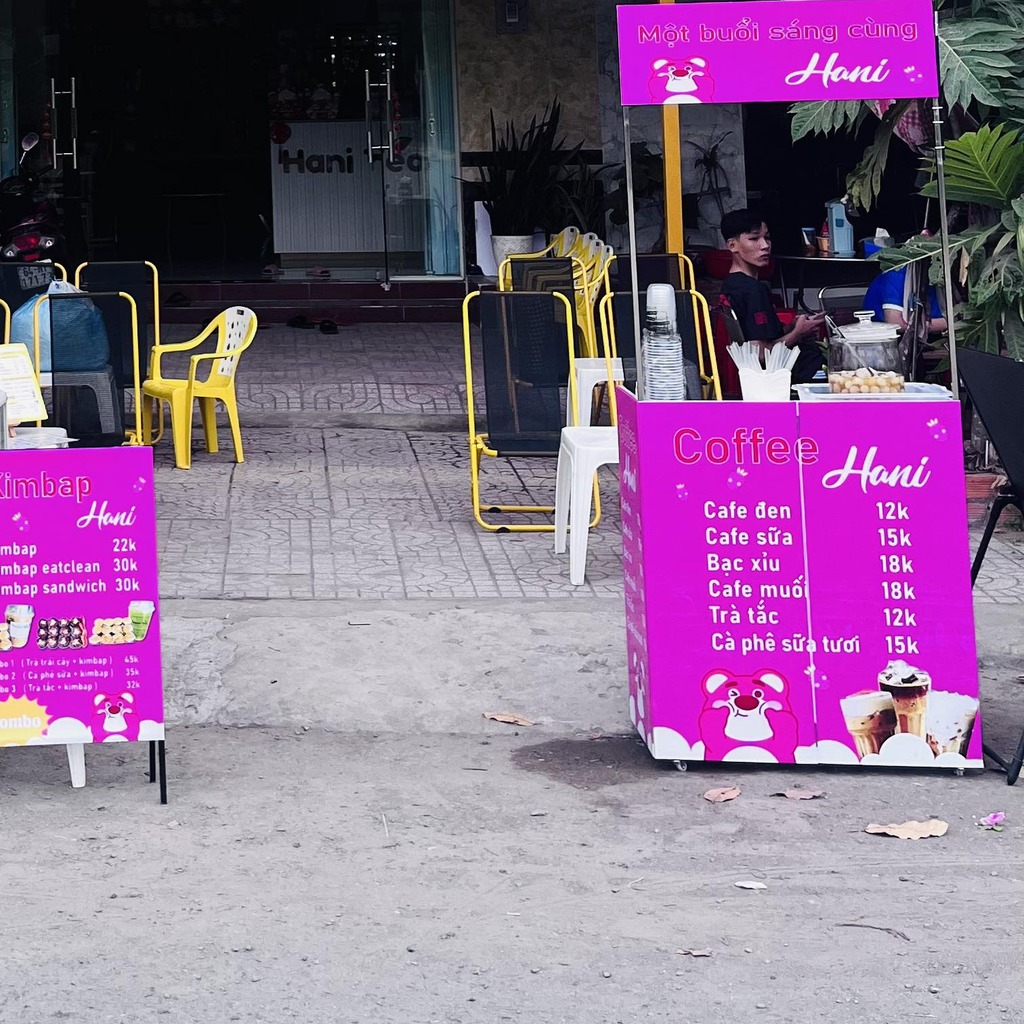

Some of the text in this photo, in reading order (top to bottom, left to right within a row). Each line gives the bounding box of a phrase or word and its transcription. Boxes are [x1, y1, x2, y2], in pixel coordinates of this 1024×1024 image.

[638, 17, 918, 48] Một buổi sáng cùng
[785, 52, 890, 88] Hani
[282, 147, 354, 174] Hani
[673, 427, 819, 465] Coffee
[821, 445, 932, 494] Hani
[76, 500, 137, 531] Hani
[703, 500, 910, 520] Cafe đen 12k
[112, 538, 137, 552] 22k
[705, 526, 912, 547] Cafe sữa 15k
[42, 559, 101, 574] eatclean
[113, 558, 138, 572] 30k
[707, 551, 914, 576] Bạc xỉu 18k
[42, 578, 107, 595] sandwich
[115, 578, 140, 592] 30k
[708, 575, 916, 600] Cafe muối 18k
[708, 599, 917, 627] Trà tắc 12k
[711, 631, 920, 656] Cà phê sữa tươi 15k
